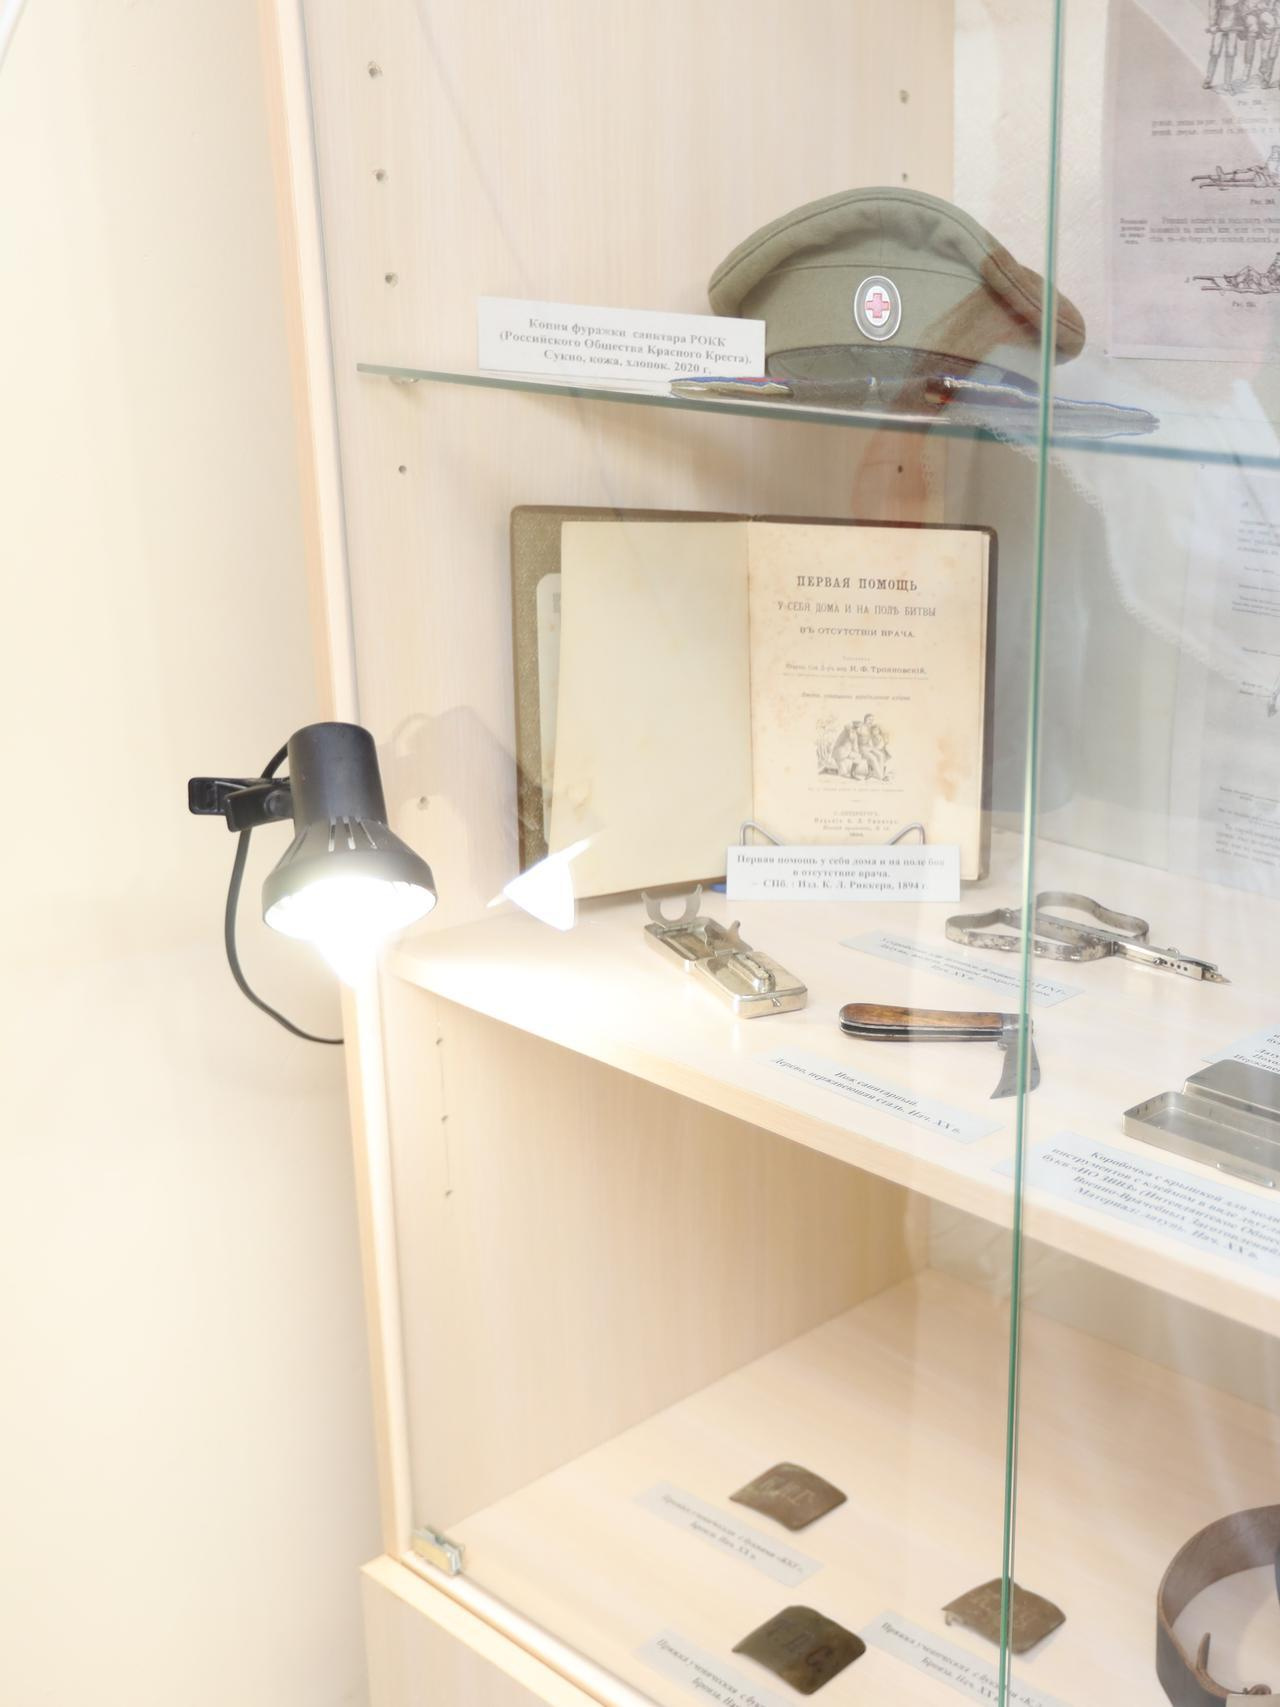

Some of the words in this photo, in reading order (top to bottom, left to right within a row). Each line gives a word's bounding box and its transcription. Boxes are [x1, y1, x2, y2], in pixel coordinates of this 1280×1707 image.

[528, 317, 569, 332] Копия
[571, 322, 627, 339] фуражки
[632, 329, 687, 345] санитара
[689, 334, 727, 348] РОКК
[499, 330, 582, 348] (Российского
[584, 337, 645, 354] Общества
[647, 343, 702, 360] Красного
[705, 349, 753, 365] Креста).
[543, 348, 586, 365] Сукно,
[588, 354, 623, 368] кожа,
[673, 361, 700, 373] 2020
[702, 366, 712, 375] г.
[796, 575, 851, 589] ПЕРВАЯ
[858, 577, 918, 592] ПОМОЩЬ
[787, 600, 811, 613] СЕБЯ
[815, 602, 841, 615] ДОМА
[844, 603, 852, 614] И
[856, 605, 870, 616] НА
[904, 607, 937, 618] БИТВЫ
[799, 626, 815, 634] ВЪ
[880, 629, 916, 639] ВРАЧА.
[736, 854, 775, 865] Первая
[776, 856, 818, 865] помощь
[827, 855, 850, 865] себя
[852, 857, 877, 865] дома
[902, 858, 925, 866] поле
[801, 869, 856, 877] отсутствие
[858, 870, 890, 878] врача.
[762, 878, 788, 888] СПб.
[849, 879, 894, 891] Риккера,
[897, 880, 919, 889] 1894
